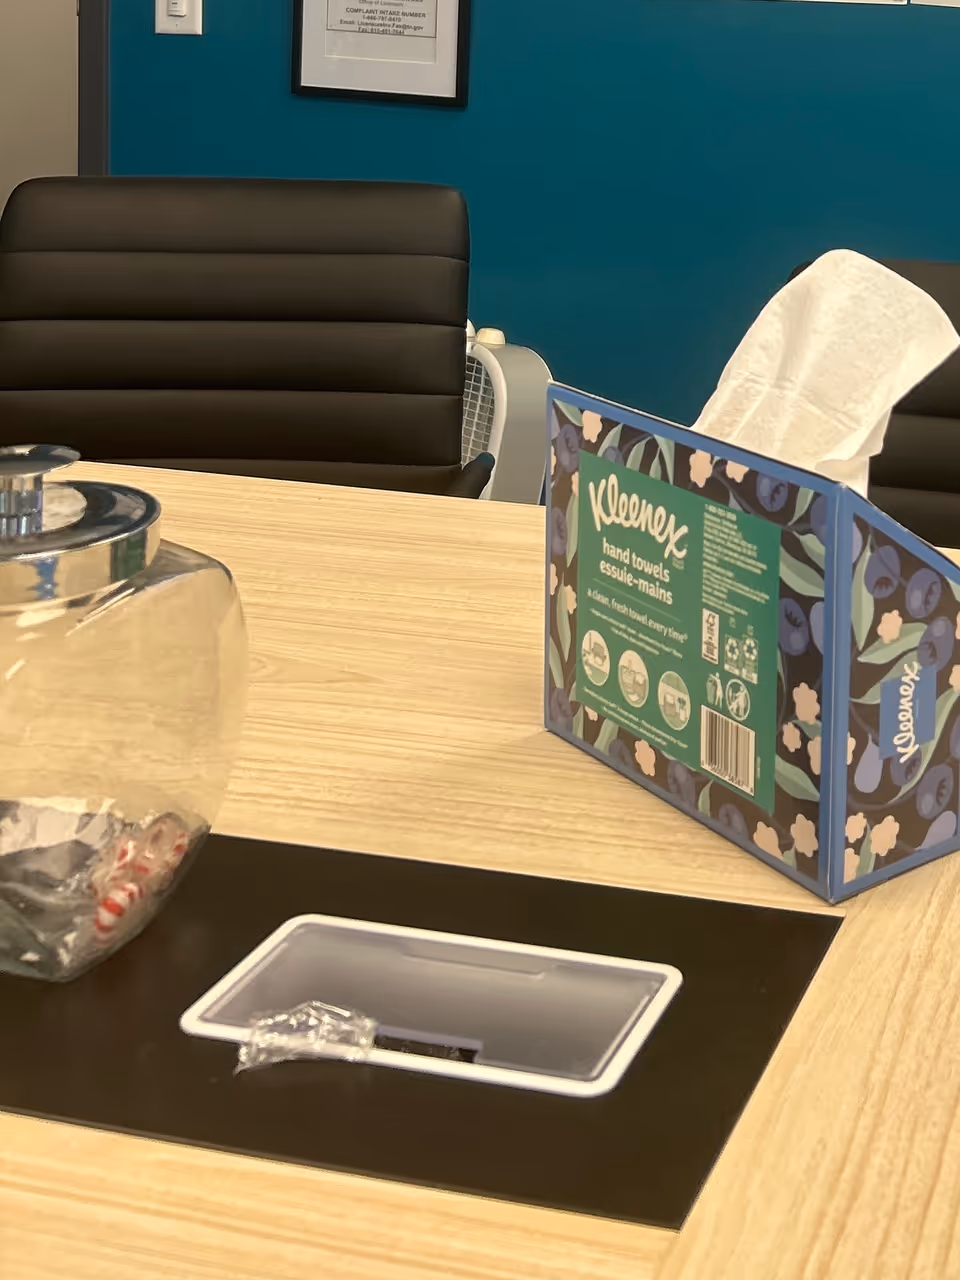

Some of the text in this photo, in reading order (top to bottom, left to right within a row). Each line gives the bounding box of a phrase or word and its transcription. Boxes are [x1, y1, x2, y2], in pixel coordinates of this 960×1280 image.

[345, 7, 378, 15] COMPLAINT
[588, 473, 689, 559] Kleenex
[600, 560, 673, 605] essuie-mains
[602, 536, 670, 583] hand towels
[611, 598, 629, 615] fresh
[648, 619, 669, 637] every
[893, 661, 922, 764] Kleenex
